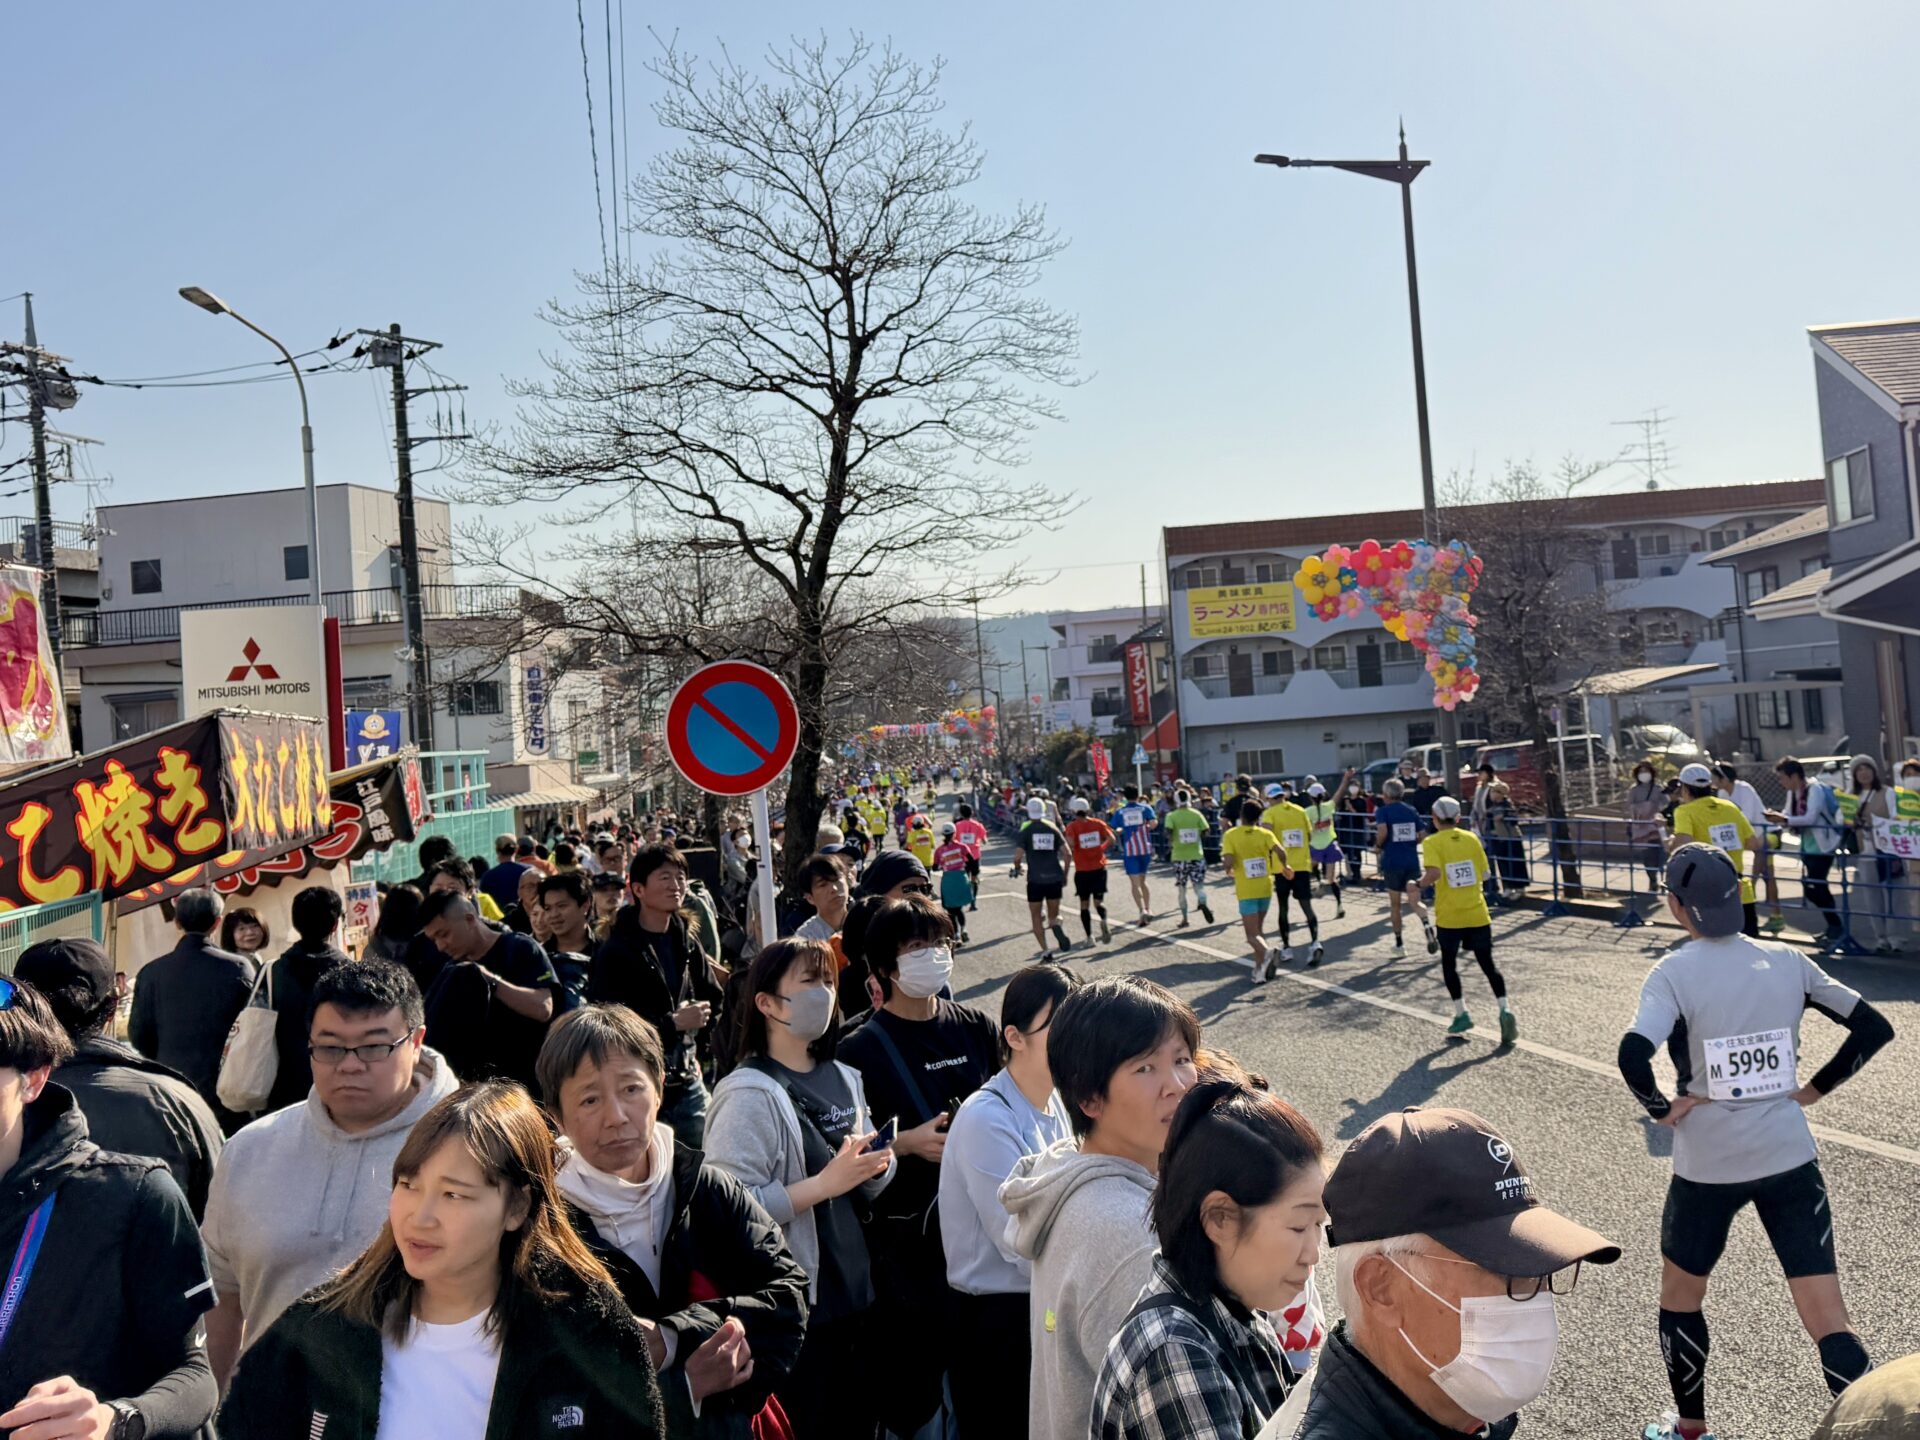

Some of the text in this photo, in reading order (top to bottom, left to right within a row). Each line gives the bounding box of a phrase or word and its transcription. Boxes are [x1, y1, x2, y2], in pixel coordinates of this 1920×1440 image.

[1193, 602, 1290, 621] ラーメン専門店
[198, 683, 310, 699] MITSUBISHI MOTORS
[356, 777, 395, 844] 江戸風味
[1711, 1064, 1722, 1079] M
[1729, 1046, 1779, 1077] 5996
